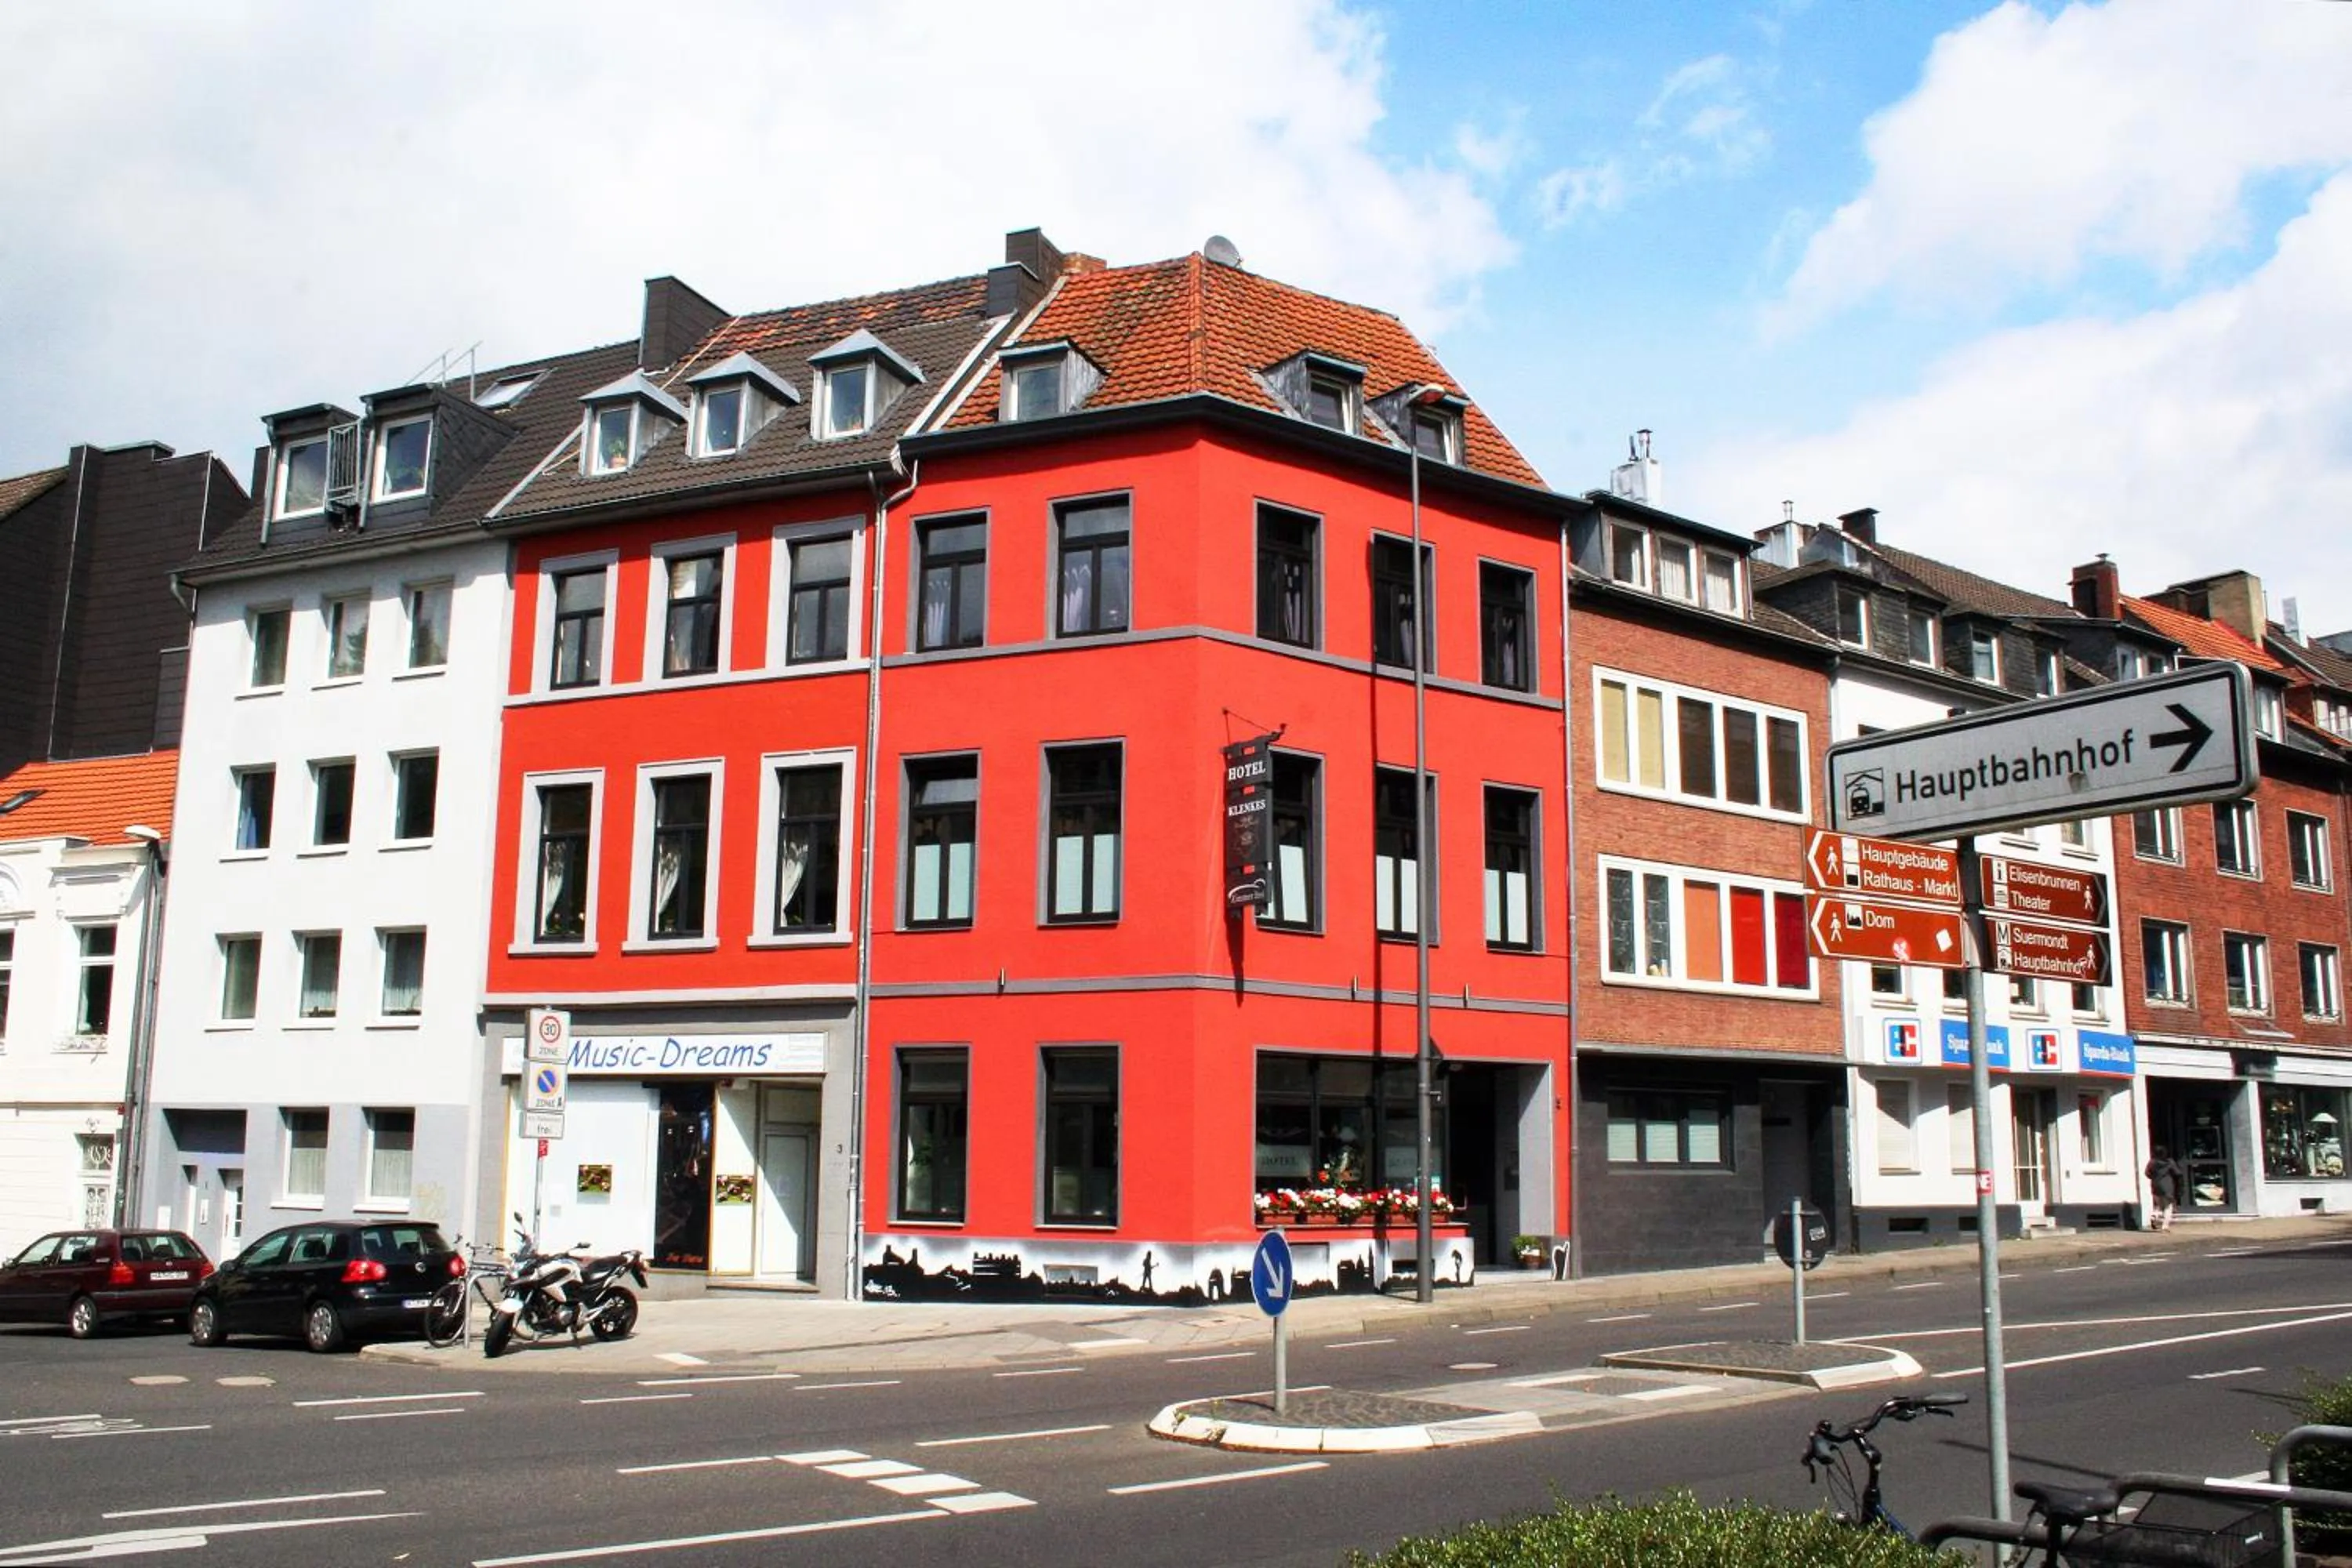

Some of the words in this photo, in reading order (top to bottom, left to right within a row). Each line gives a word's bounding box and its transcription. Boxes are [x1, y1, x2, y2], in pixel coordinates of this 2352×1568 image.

[1228, 760, 1267, 781] HOTEL
[1896, 728, 2135, 804] Hauptbahnhof
[1228, 800, 1267, 817] KLENKES
[1862, 844, 1949, 872] Hauptgebäude
[1864, 869, 1914, 891] Rathaus
[1924, 877, 1958, 898] Markt
[2009, 866, 2082, 891] Elisenbrunnen
[2010, 890, 2052, 911] Theater
[1865, 910, 1895, 929] Dom
[2013, 927, 2069, 950] Suermondt
[543, 1022, 557, 1036] 30
[539, 1047, 559, 1055] ZONE
[567, 1038, 772, 1069] Music-Dreams
[1947, 1032, 2005, 1054] Sparank
[535, 1098, 556, 1108] ZONE
